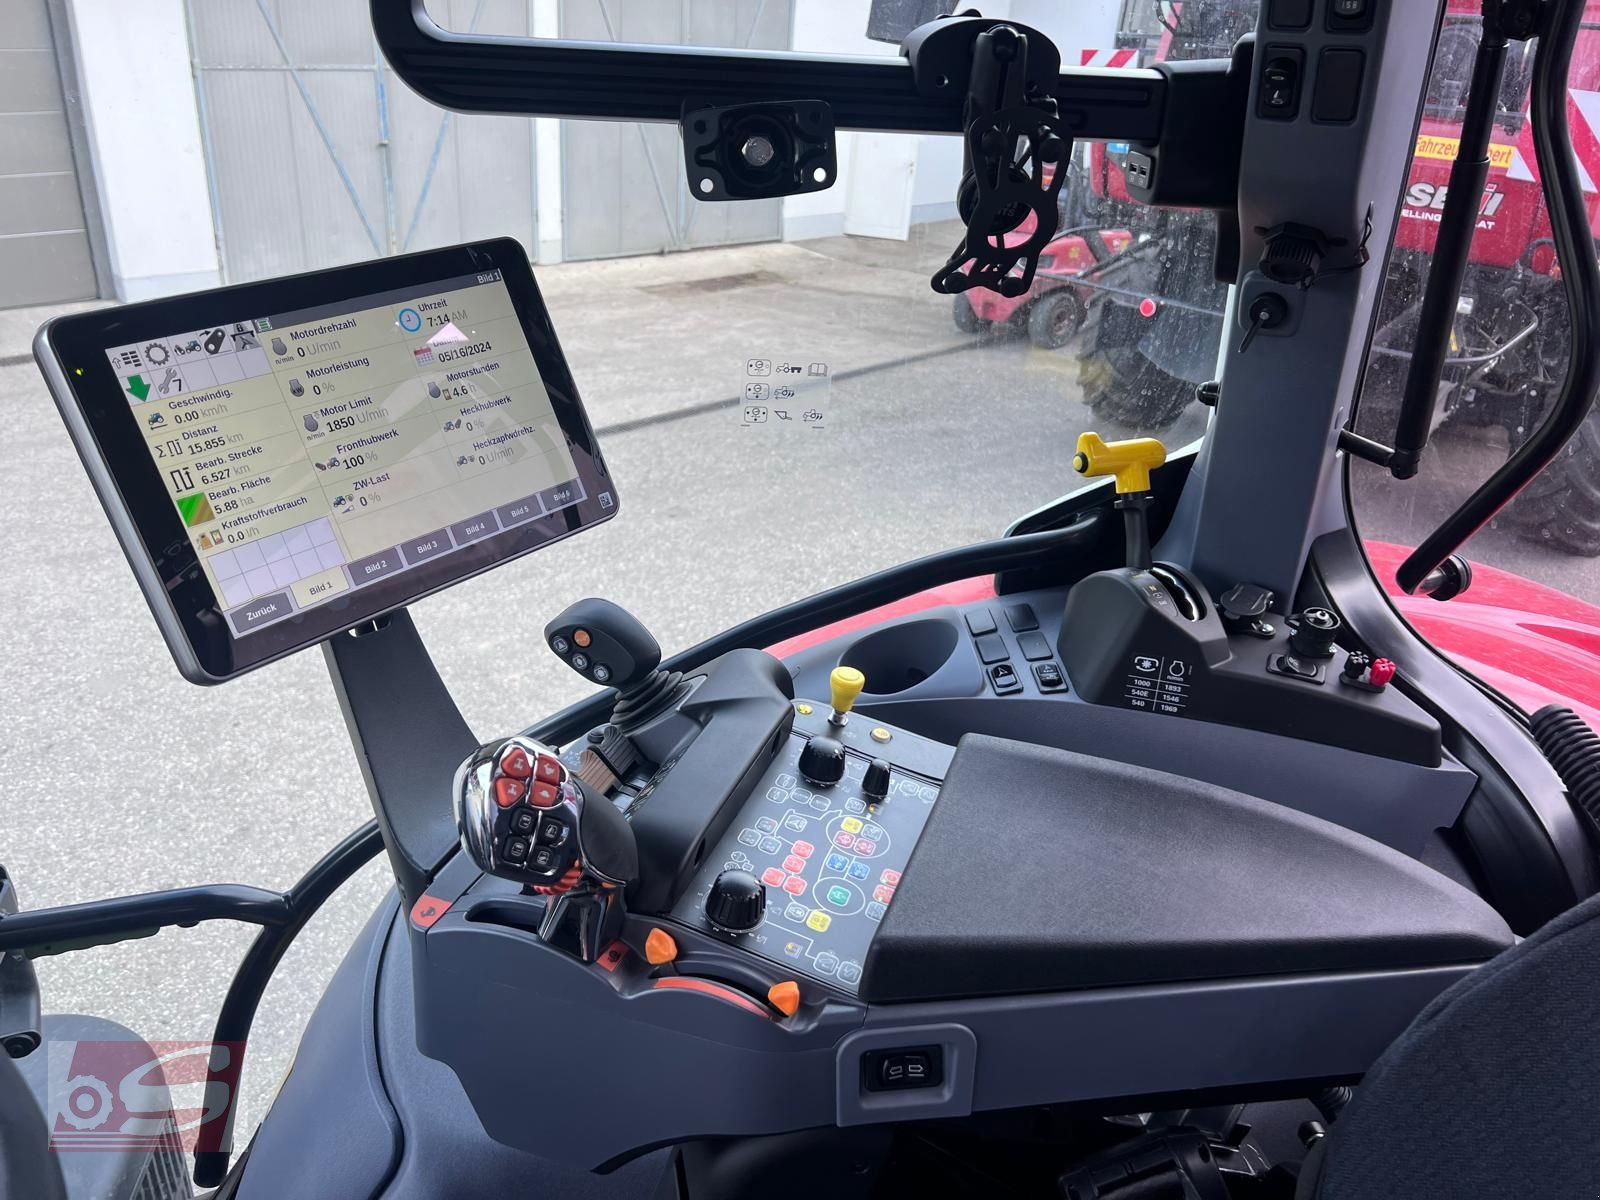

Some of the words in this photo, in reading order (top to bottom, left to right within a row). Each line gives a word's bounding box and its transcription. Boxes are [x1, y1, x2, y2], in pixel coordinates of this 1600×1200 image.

[477, 274, 494, 284] Bild
[495, 272, 500, 280] 1
[418, 299, 448, 312] Uhrzeit
[426, 313, 450, 327] 7:14
[451, 310, 468, 320] AM
[290, 319, 357, 341] Motordrehzahl
[297, 347, 305, 357] 0
[306, 340, 341, 355] U/min
[438, 341, 492, 363] 05/16/2024
[275, 355, 295, 365] n/min
[306, 357, 370, 378] Motorleistung
[446, 361, 500, 383] Motorstunden
[313, 385, 321, 395] 0
[322, 381, 336, 392] %
[452, 385, 468, 397] 4.6
[468, 382, 477, 392] h
[168, 389, 233, 410] Geschwindig.
[320, 404, 347, 417] Motor
[349, 396, 373, 409] Limit
[460, 395, 512, 416] Heckhubwerk
[174, 410, 199, 424] 0.00
[201, 403, 228, 417] km/h
[326, 416, 355, 432] 1850
[356, 407, 390, 424] U/min
[181, 425, 219, 441] Distanz
[466, 422, 473, 431] 0
[188, 436, 226, 455] 15.855
[226, 433, 245, 444] km
[336, 429, 399, 454] Fronthubwerk
[472, 426, 536, 451] Heckzapfwdrehz.
[195, 456, 227, 471] Bearb.
[228, 445, 263, 462] Strecke
[342, 455, 365, 470] 100
[365, 451, 378, 461] %
[478, 455, 485, 465] 0
[486, 446, 514, 463] U/min
[201, 468, 231, 485] 6.527
[233, 464, 251, 475] km
[353, 473, 391, 491] ZW-Last
[208, 485, 240, 501] Bearb.
[241, 475, 272, 491] Fläche
[553, 492, 566, 501] Bild
[214, 499, 239, 515] 5.88
[239, 495, 255, 507] ha
[360, 496, 368, 506] 0
[368, 492, 381, 502] %
[221, 495, 308, 530] Kraftstoffverbrauch
[511, 507, 524, 518] Bild
[227, 531, 245, 544] 0.0
[245, 526, 260, 538] l/h
[465, 525, 480, 535] Bild
[417, 543, 433, 554] Bild
[364, 563, 381, 574] Bild
[381, 560, 387, 568] 2
[309, 584, 325, 596] Bild
[246, 603, 277, 621] Zurück
[1134, 679, 1151, 687] 1000
[1165, 684, 1182, 692] 1893
[1131, 689, 1149, 697] 540E
[1163, 694, 1180, 703] 1546
[1131, 699, 1145, 707] 540
[1161, 704, 1178, 713] 1969
